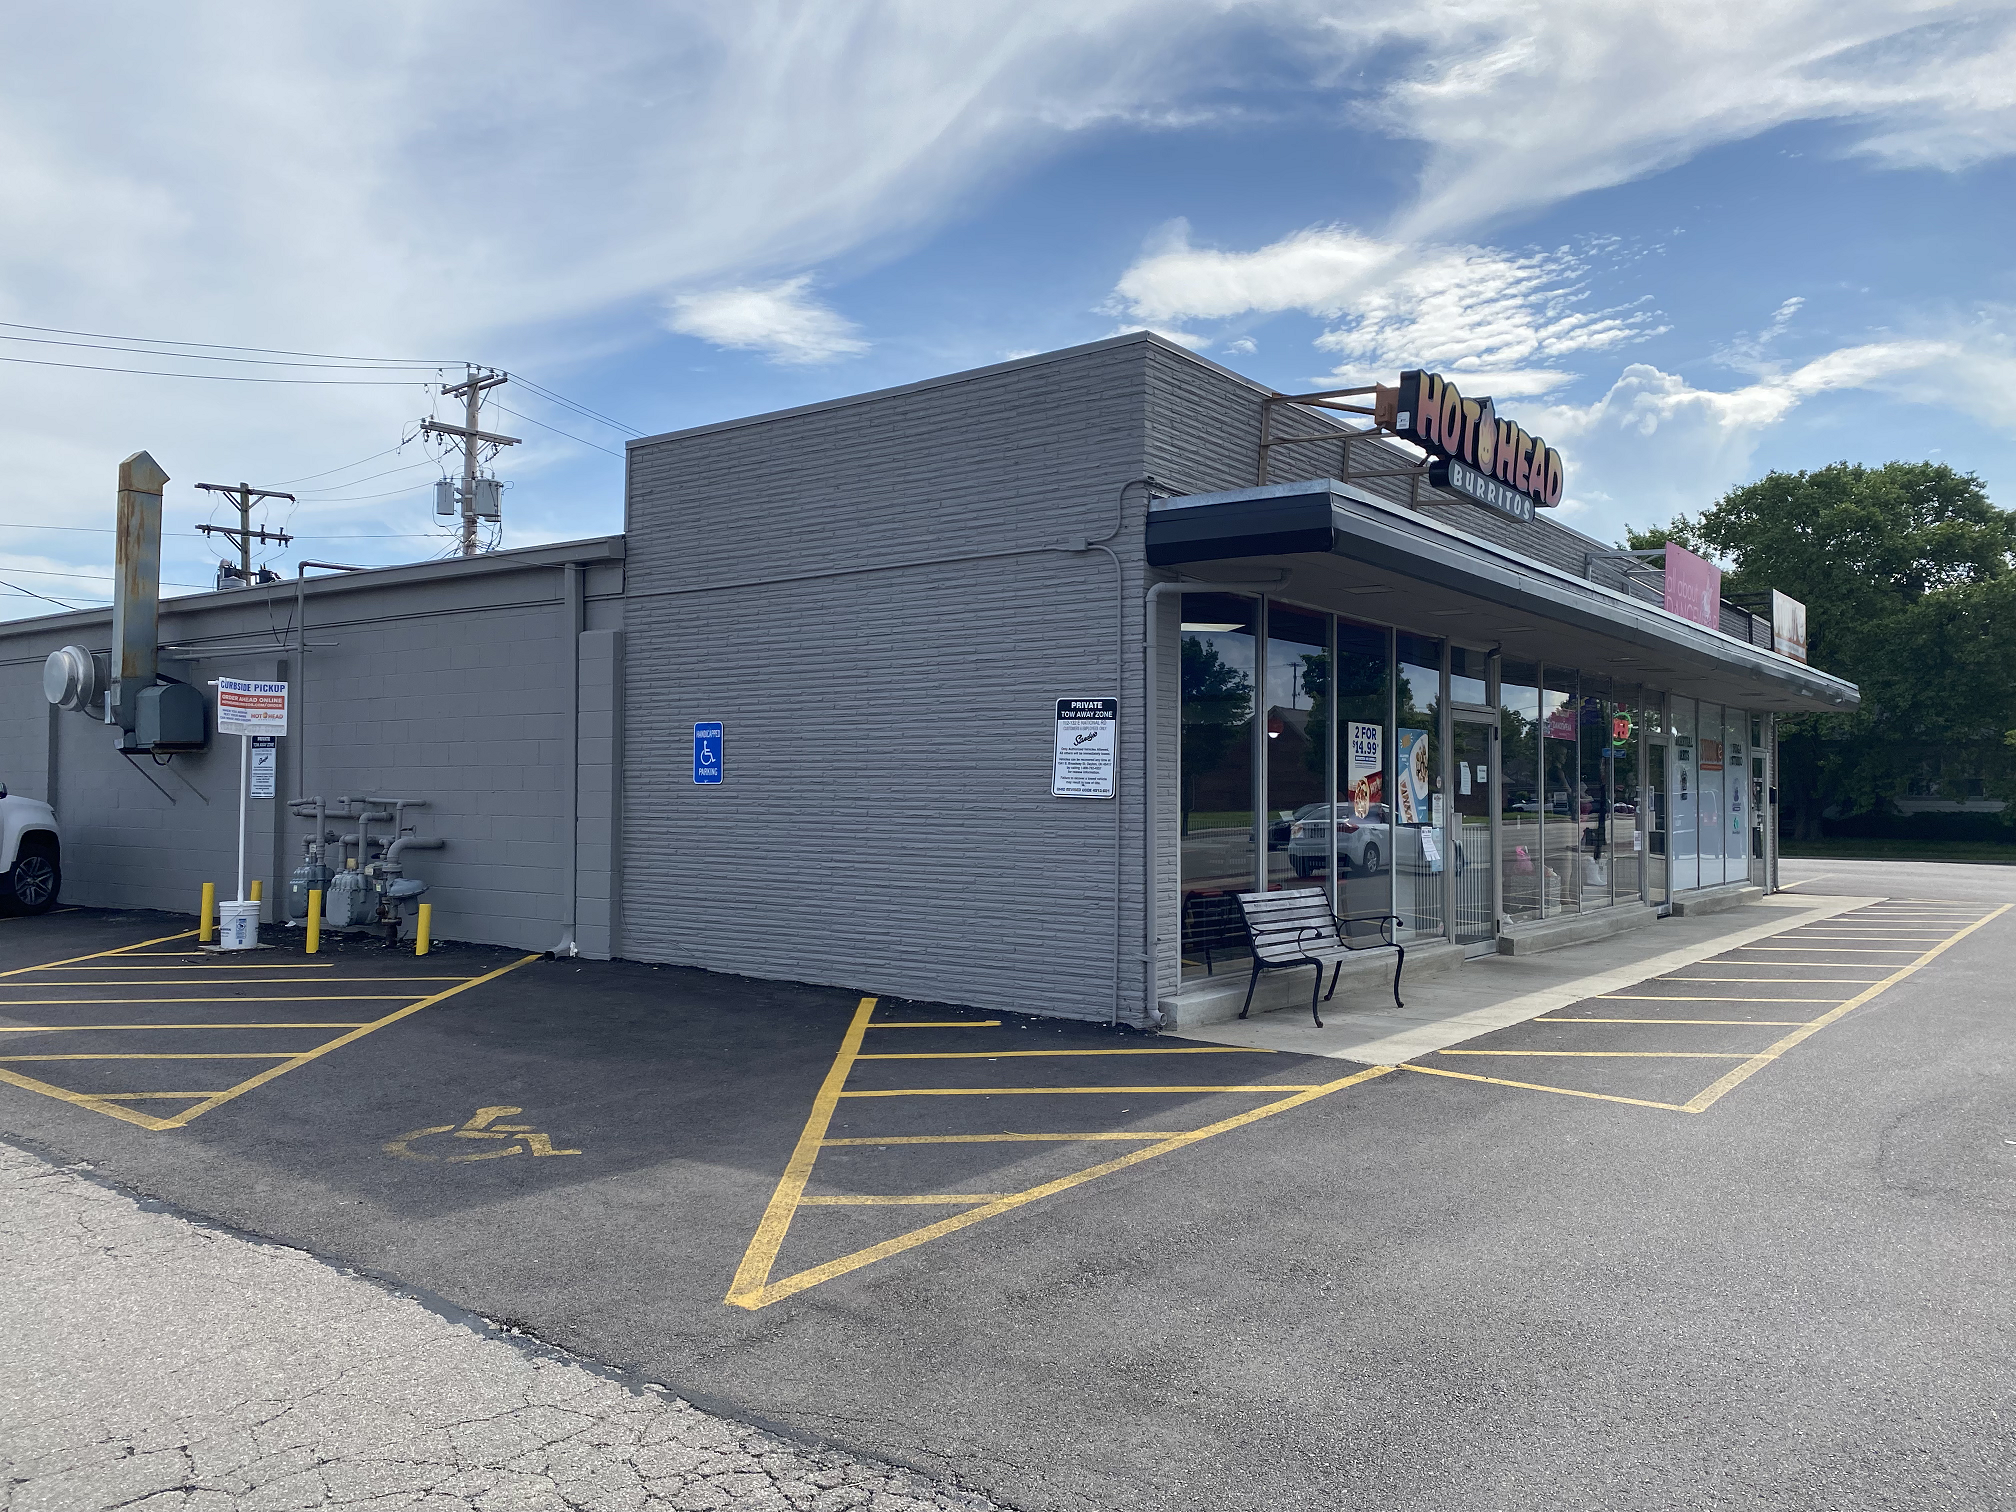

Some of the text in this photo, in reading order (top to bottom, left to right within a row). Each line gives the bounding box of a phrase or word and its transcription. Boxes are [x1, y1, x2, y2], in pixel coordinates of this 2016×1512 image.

[1416, 369, 1563, 508] HOT HEAD
[1453, 464, 1531, 520] BURRITOS
[1666, 568, 1698, 602] all about
[221, 680, 285, 692] CURBSIDE PICKUP
[1355, 726, 1376, 740] 2 FOR
